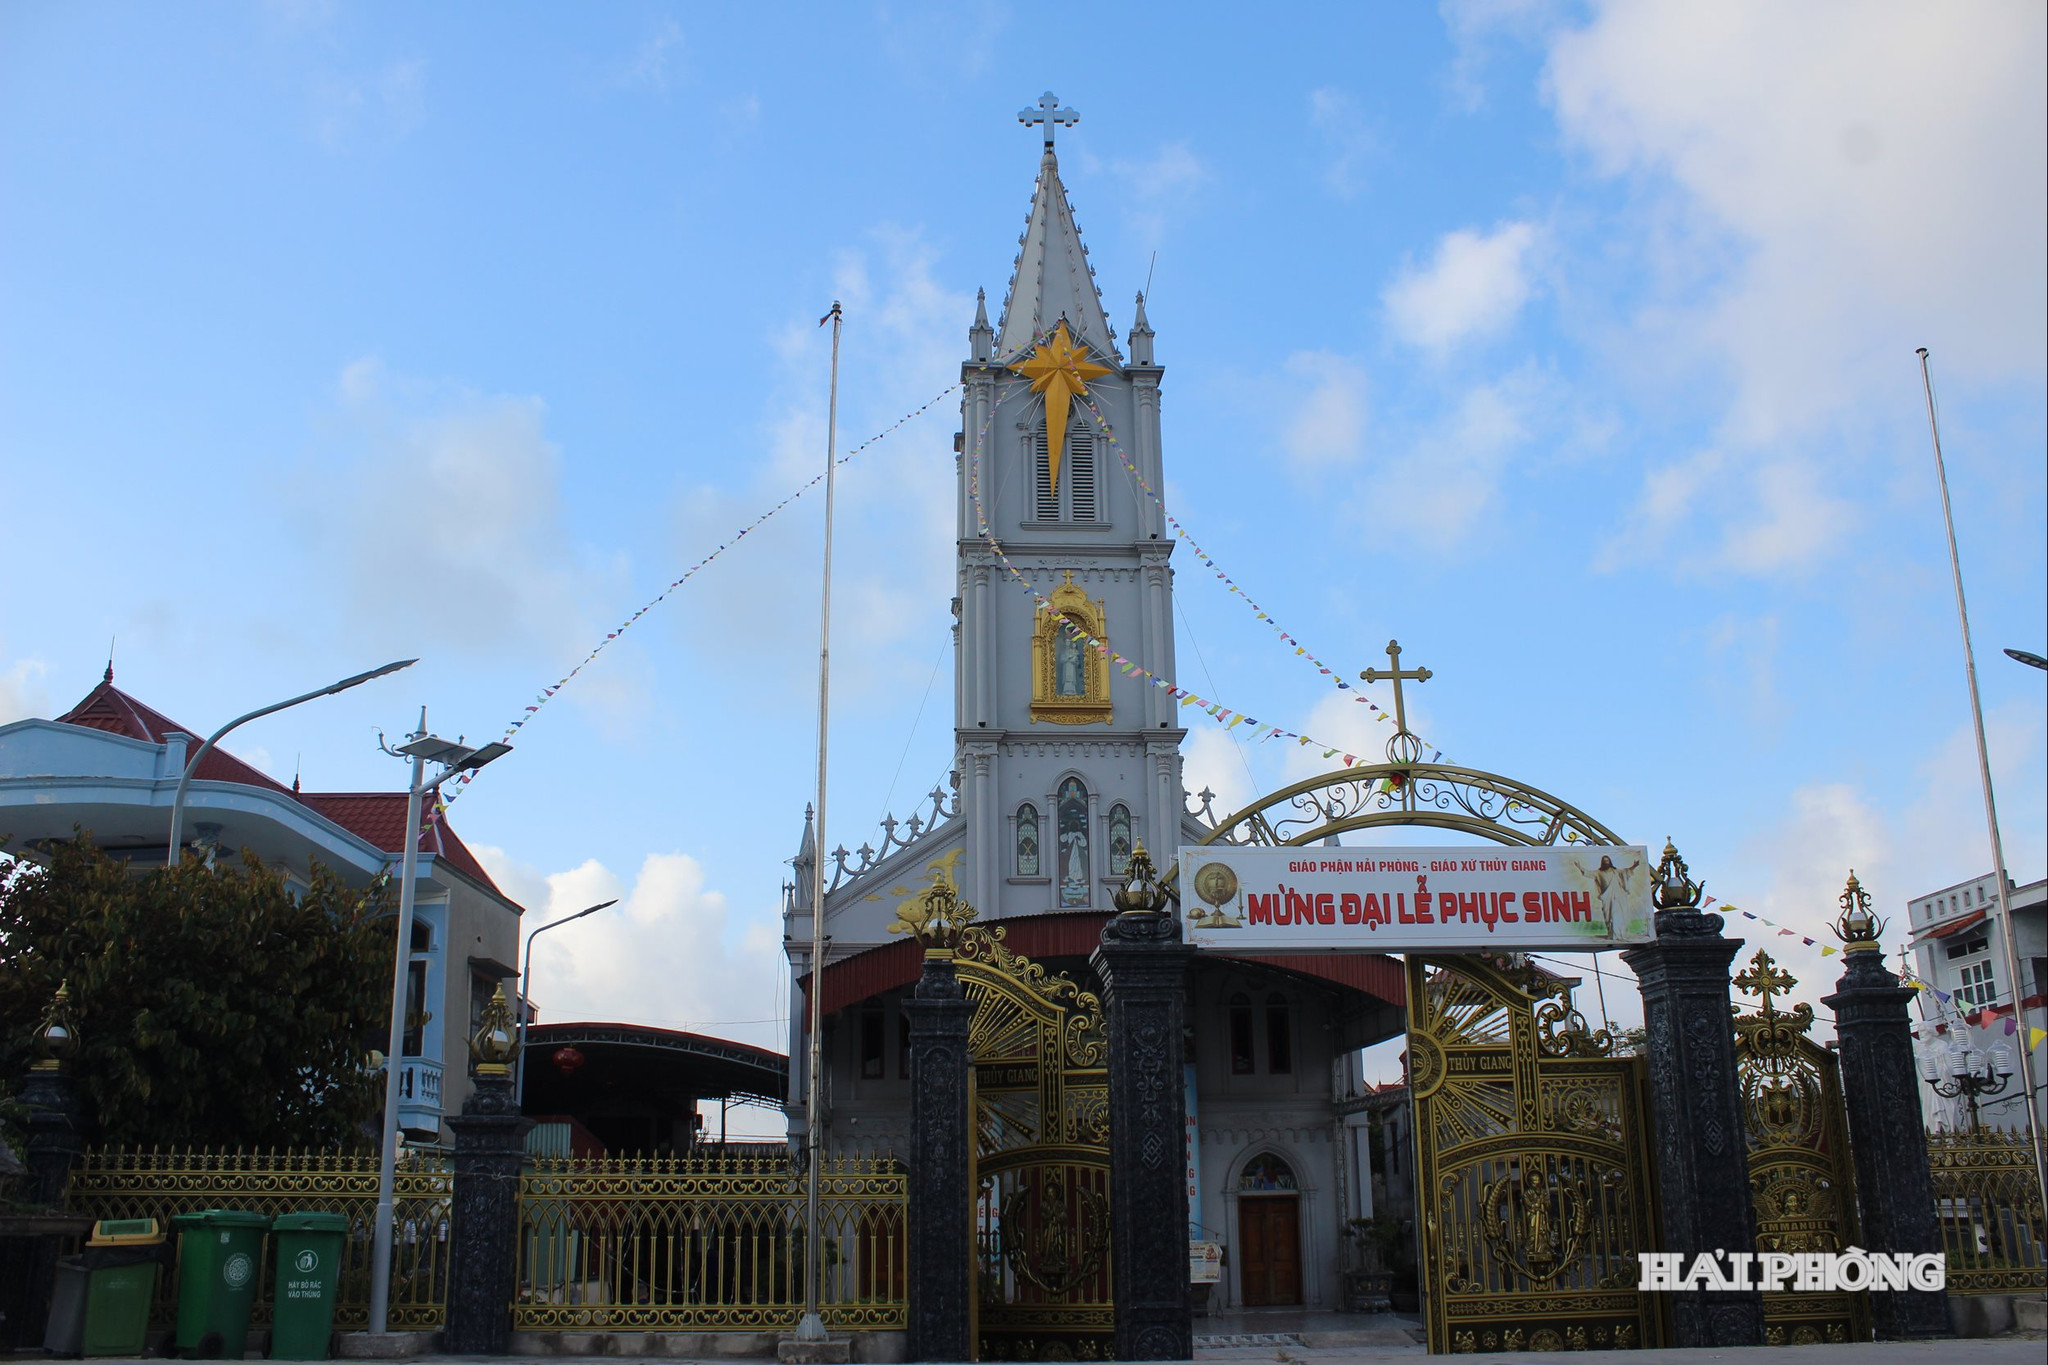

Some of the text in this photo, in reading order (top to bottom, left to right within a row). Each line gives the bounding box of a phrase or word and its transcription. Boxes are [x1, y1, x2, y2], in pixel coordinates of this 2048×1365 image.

[1289, 859, 1317, 872] GIÁO
[1320, 859, 1353, 875] PHẬN
[1356, 857, 1376, 872] HẢI
[1379, 859, 1419, 872] PHÒNG
[1430, 859, 1457, 872] GIÁO
[1461, 859, 1477, 872] XỨ
[1479, 857, 1508, 872] THỦY
[1511, 860, 1547, 871] GIANG
[1248, 874, 1592, 933] MỪNG ĐẠI LỄ PHỤC SINH
[1448, 1052, 1512, 1071] THỦY GIANG
[1007, 1068, 1038, 1082] GIANG
[1761, 1221, 1830, 1232] EMMANUEL
